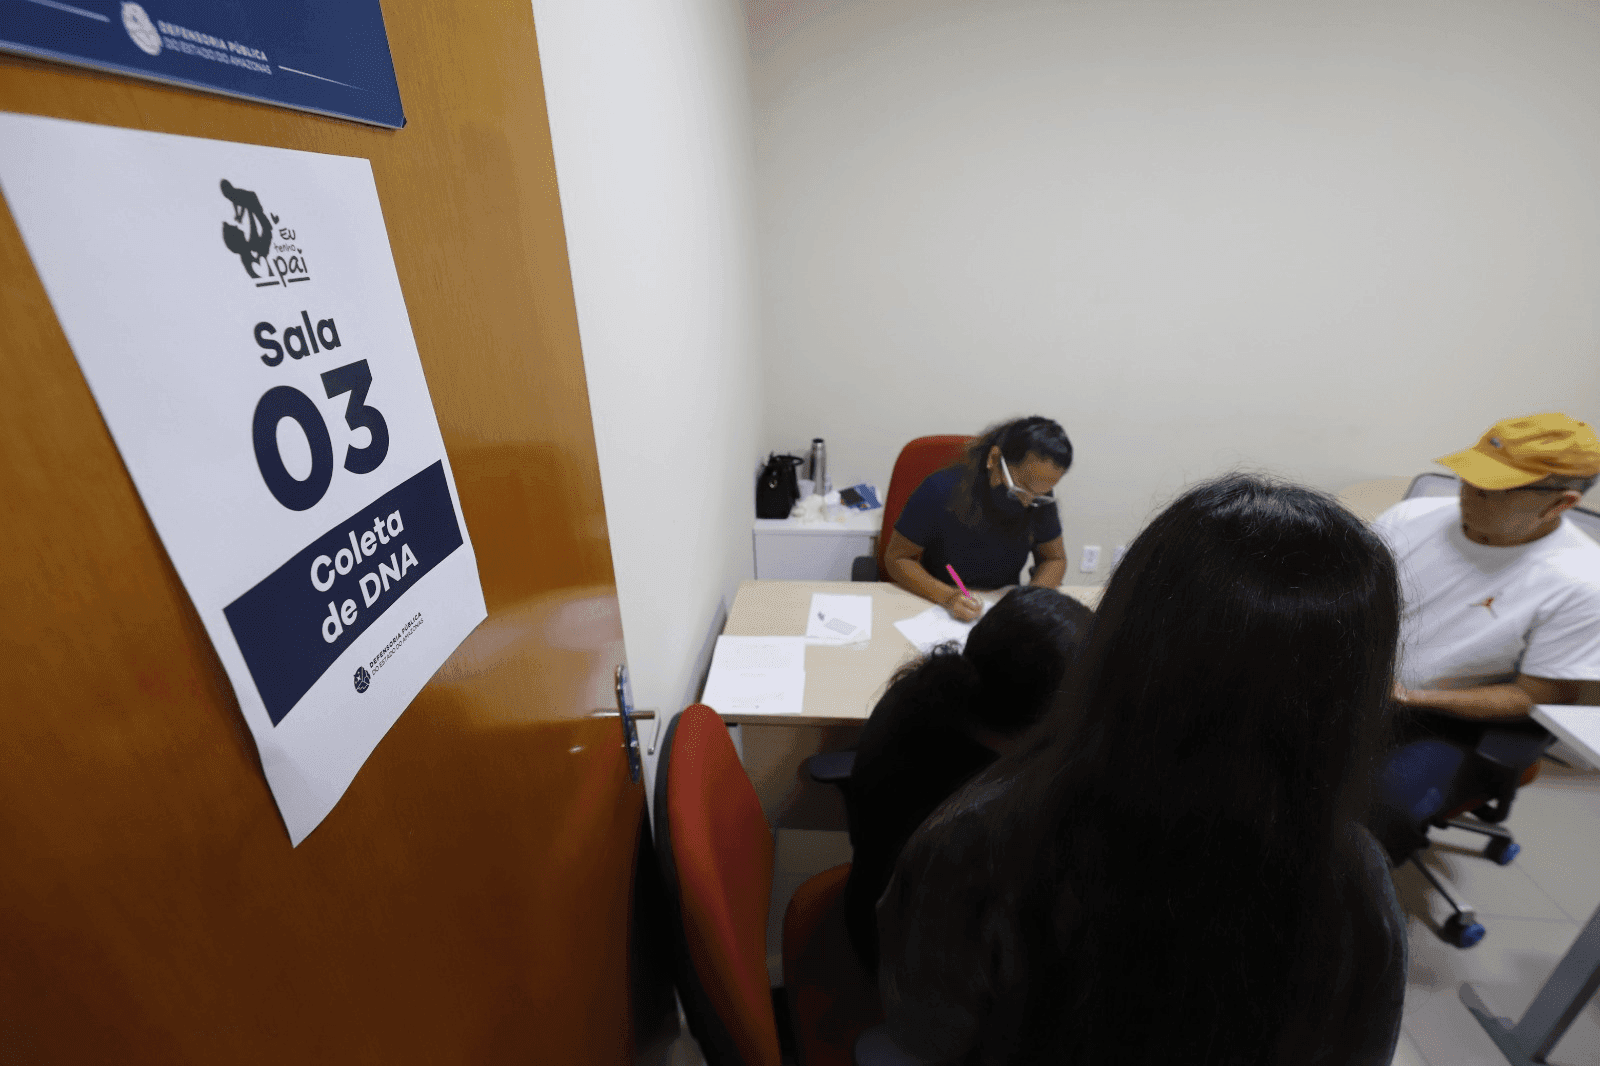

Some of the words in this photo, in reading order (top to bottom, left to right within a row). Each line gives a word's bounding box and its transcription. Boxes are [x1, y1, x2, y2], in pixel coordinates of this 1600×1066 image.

[272, 248, 308, 288] pai
[273, 243, 296, 254] tenho
[253, 310, 342, 367] Sala
[252, 358, 390, 512] 03
[310, 509, 404, 592] Coleta
[322, 598, 358, 644] de
[359, 543, 419, 609] DNA
[369, 633, 402, 668] DEFENSORIA
[401, 612, 421, 634] PÚBLICA
[371, 665, 380, 676] DO
[379, 647, 396, 668] ESTADO
[395, 640, 403, 650] DO
[402, 617, 424, 644] AMAZONAS
